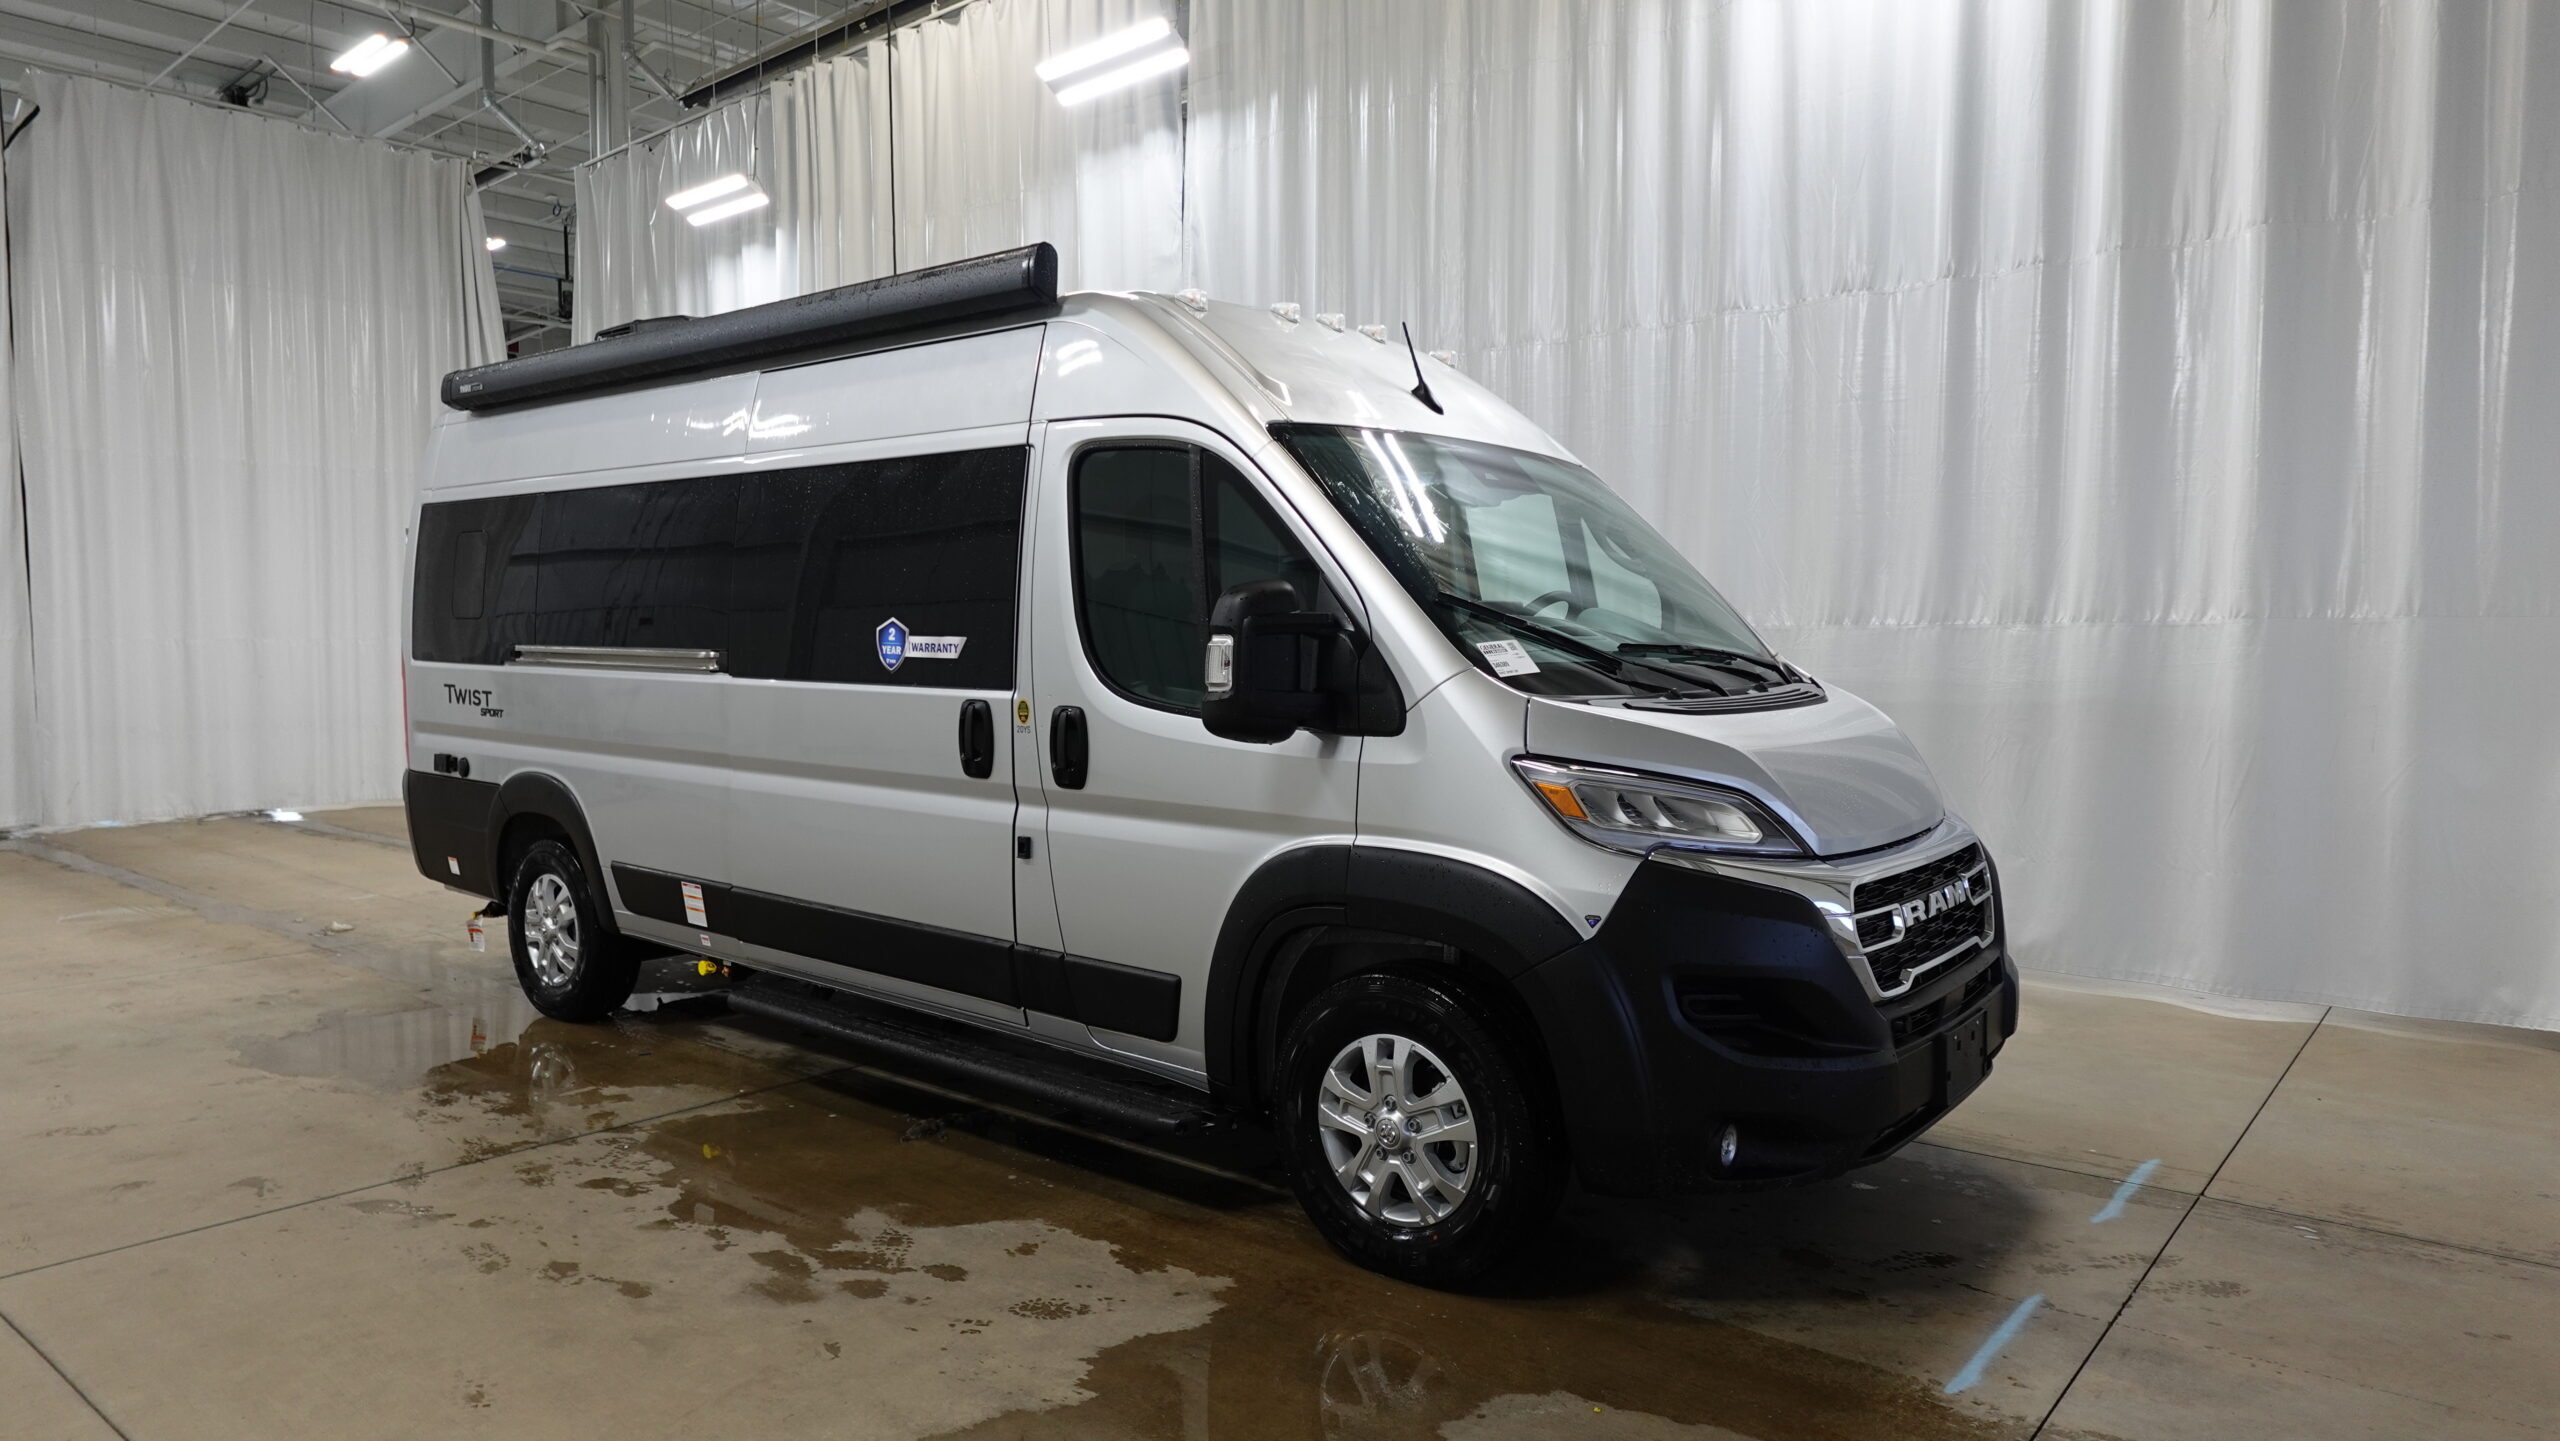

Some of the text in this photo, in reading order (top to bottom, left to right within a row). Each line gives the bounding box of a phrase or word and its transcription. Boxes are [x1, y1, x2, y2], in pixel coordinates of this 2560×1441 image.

[888, 627, 896, 640] 2
[881, 645, 902, 655] YEAR
[911, 642, 960, 653] WARRANTY
[480, 708, 504, 718] SPORT
[1901, 880, 1967, 928] RAM
